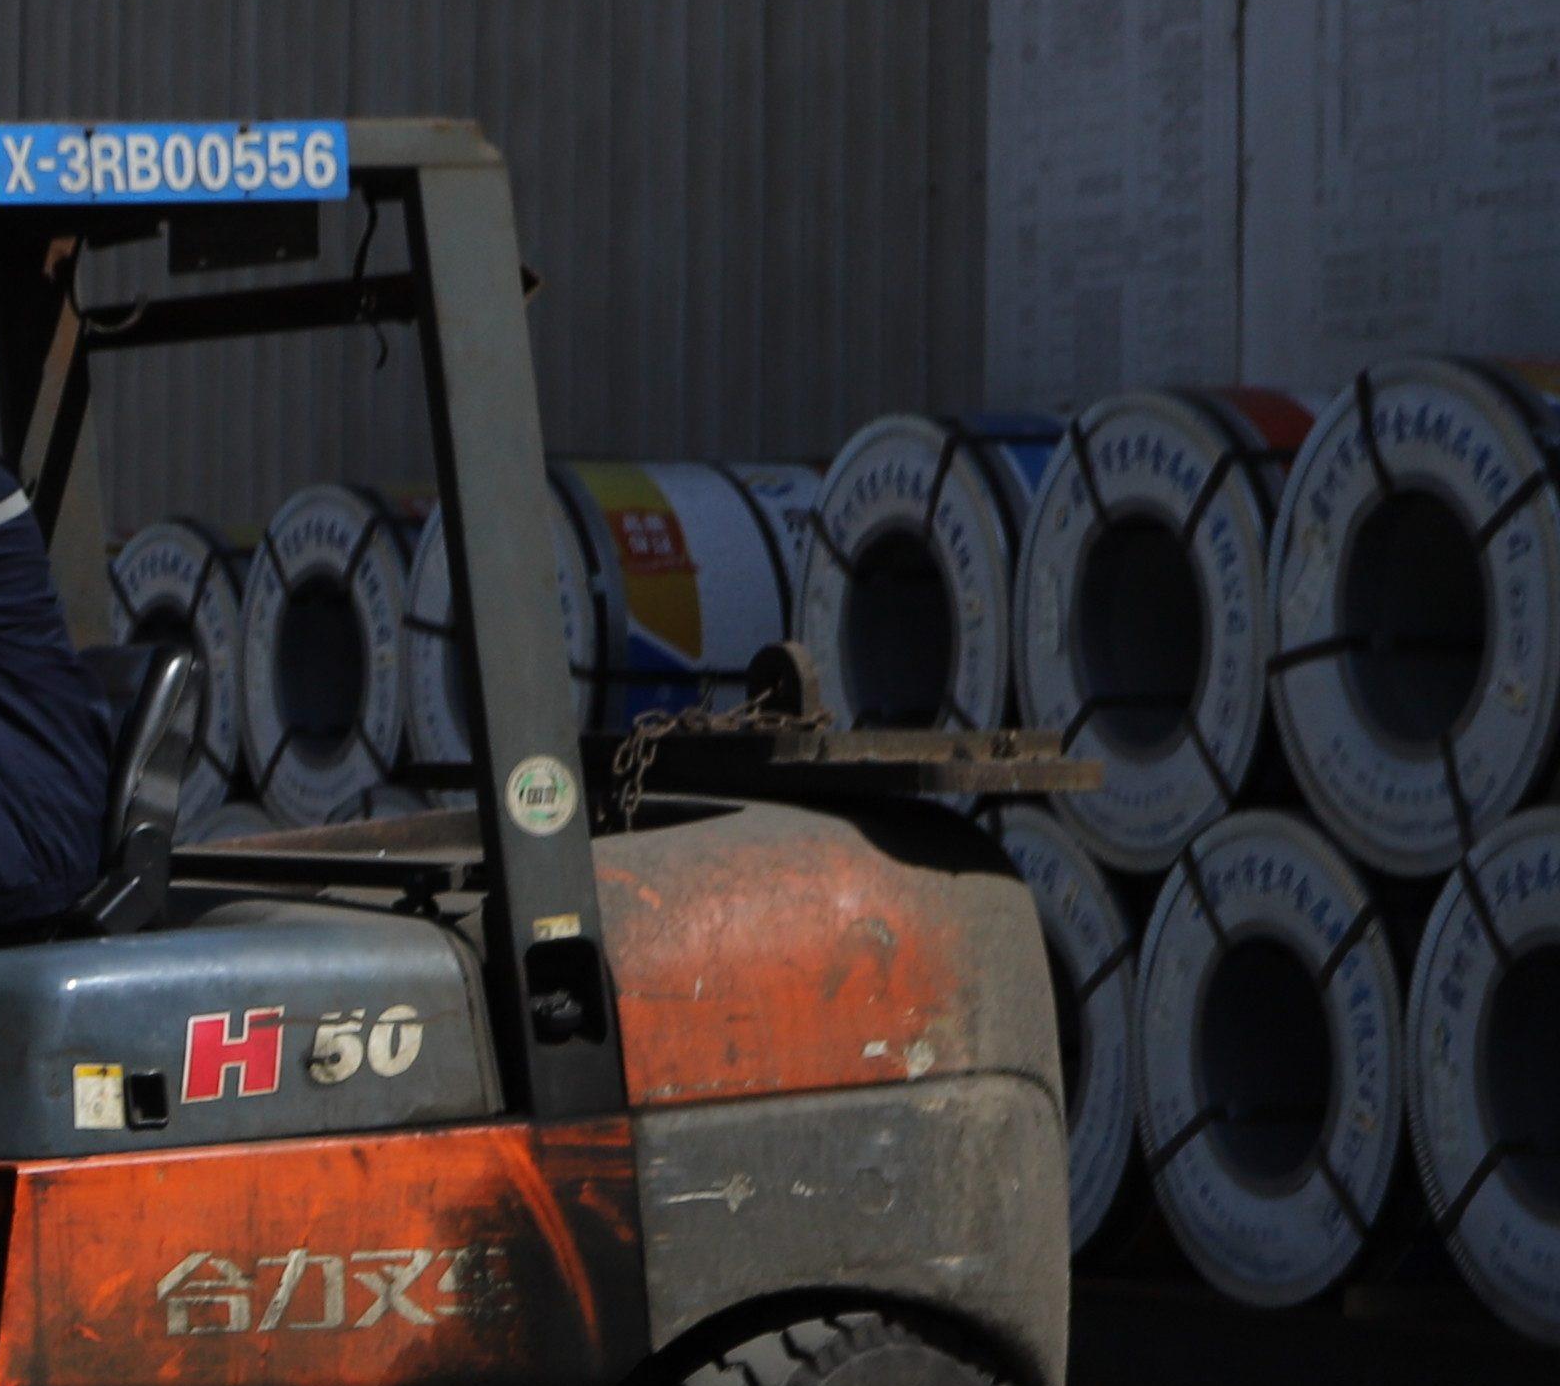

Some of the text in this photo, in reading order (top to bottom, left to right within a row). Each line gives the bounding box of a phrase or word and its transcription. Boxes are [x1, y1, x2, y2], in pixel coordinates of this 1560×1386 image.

[2, 130, 337, 194] X-3RB00556
[180, 1005, 286, 1104] H
[306, 1004, 423, 1085] 50
